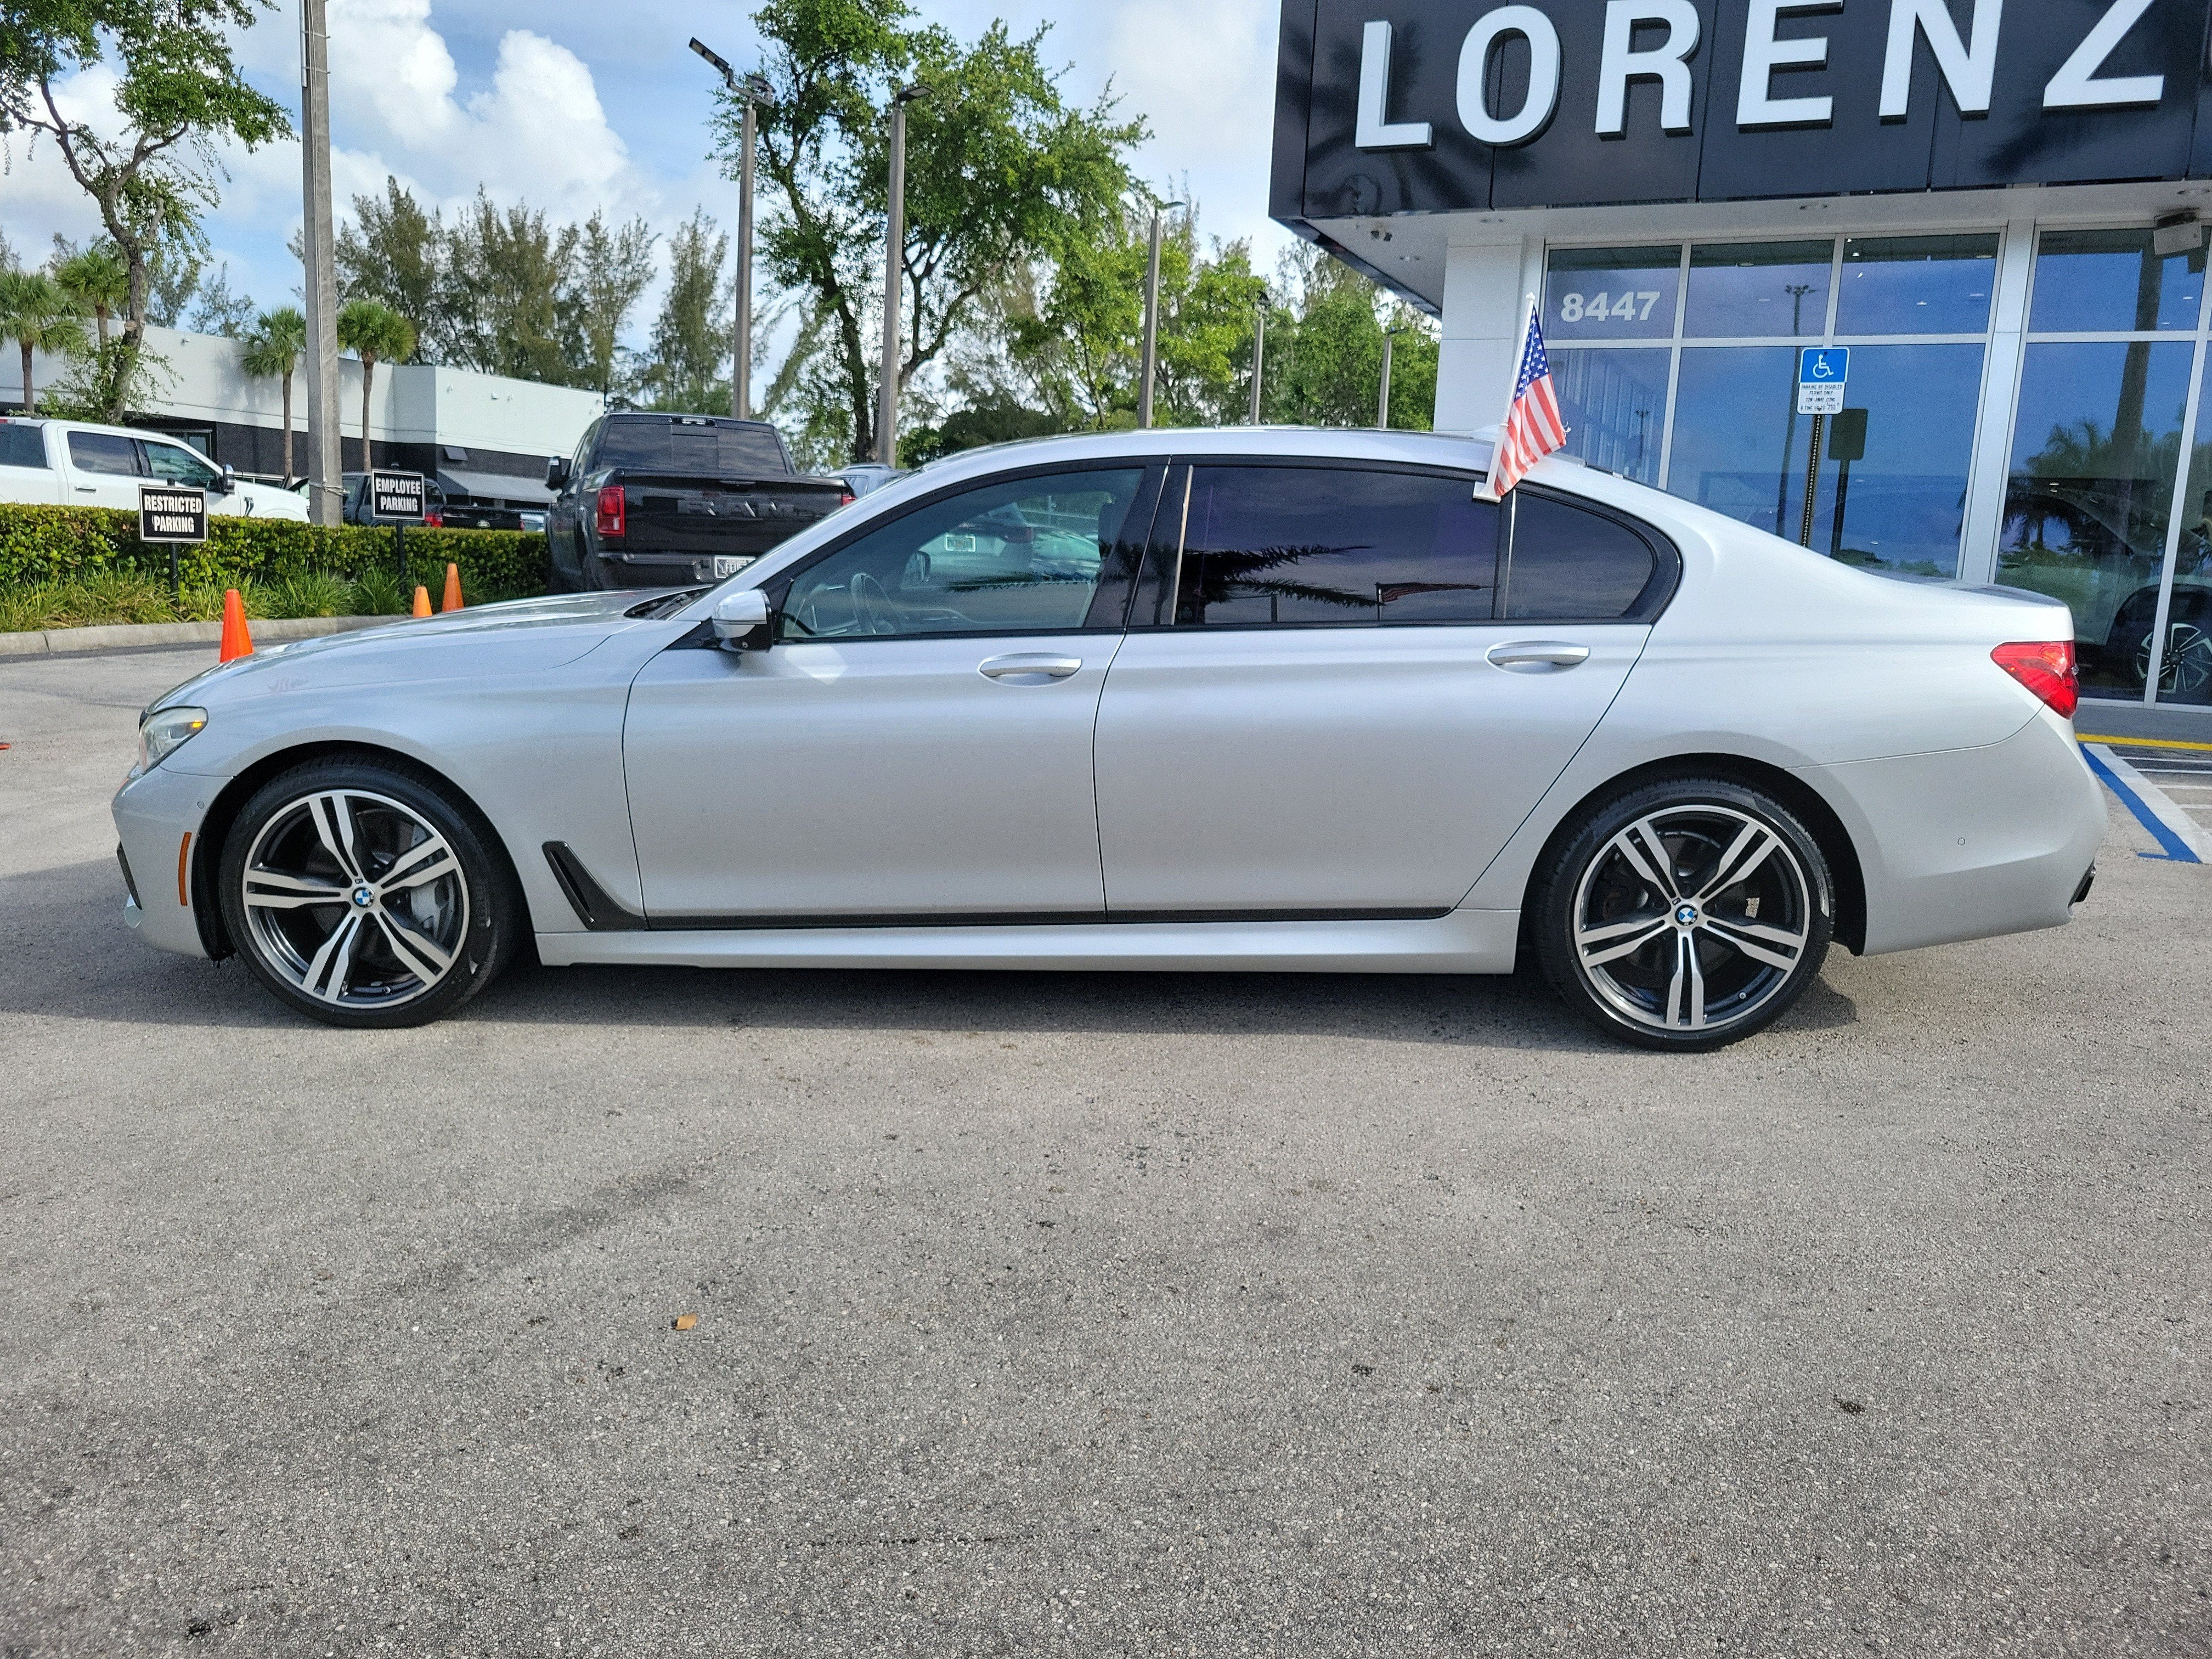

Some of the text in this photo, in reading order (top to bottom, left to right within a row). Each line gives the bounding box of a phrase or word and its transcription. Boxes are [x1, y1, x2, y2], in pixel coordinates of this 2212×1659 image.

[1355, 0, 2212, 148] LORENZ
[1561, 291, 1661, 323] 8447
[375, 477, 421, 495] EMPLOYEE
[144, 494, 202, 513] RESTRICTED
[380, 495, 418, 512] PARKING
[678, 500, 795, 517] RAM
[154, 515, 195, 533] PARKING
